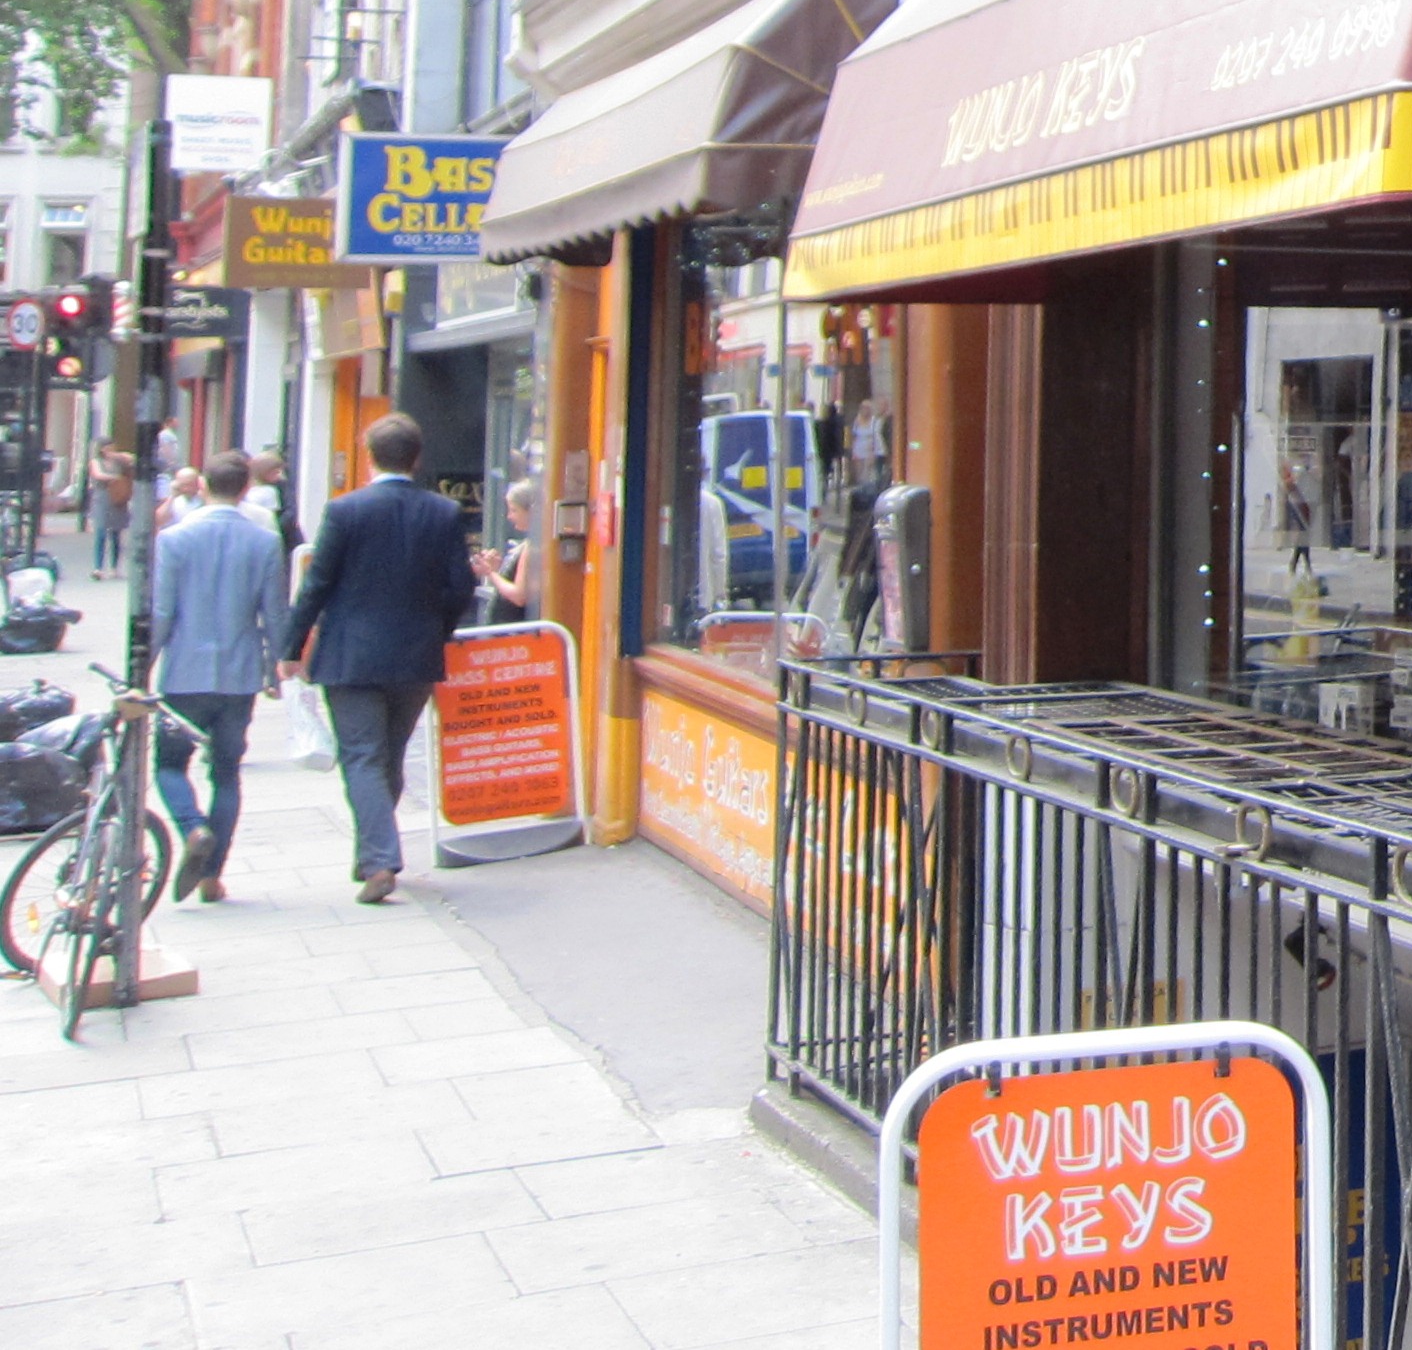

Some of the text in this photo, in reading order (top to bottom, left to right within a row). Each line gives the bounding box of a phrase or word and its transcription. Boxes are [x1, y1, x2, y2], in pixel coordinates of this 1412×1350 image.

[1040, 35, 1146, 139] KEYS
[384, 145, 496, 198] BAS
[250, 206, 333, 241] Wunj
[367, 192, 488, 234] CELL
[242, 236, 335, 264] Guita
[13, 312, 37, 334] 30
[459, 698, 543, 714] INSTRUMENTS
[460, 684, 540, 700] OLD AND NEW
[497, 715, 521, 724] AND
[970, 1092, 1247, 1181] WUNJO
[1004, 1176, 1214, 1261] KEYS
[988, 1255, 1228, 1305] OLD AND NEW
[983, 1299, 1234, 1350] INSTRUMENTS
